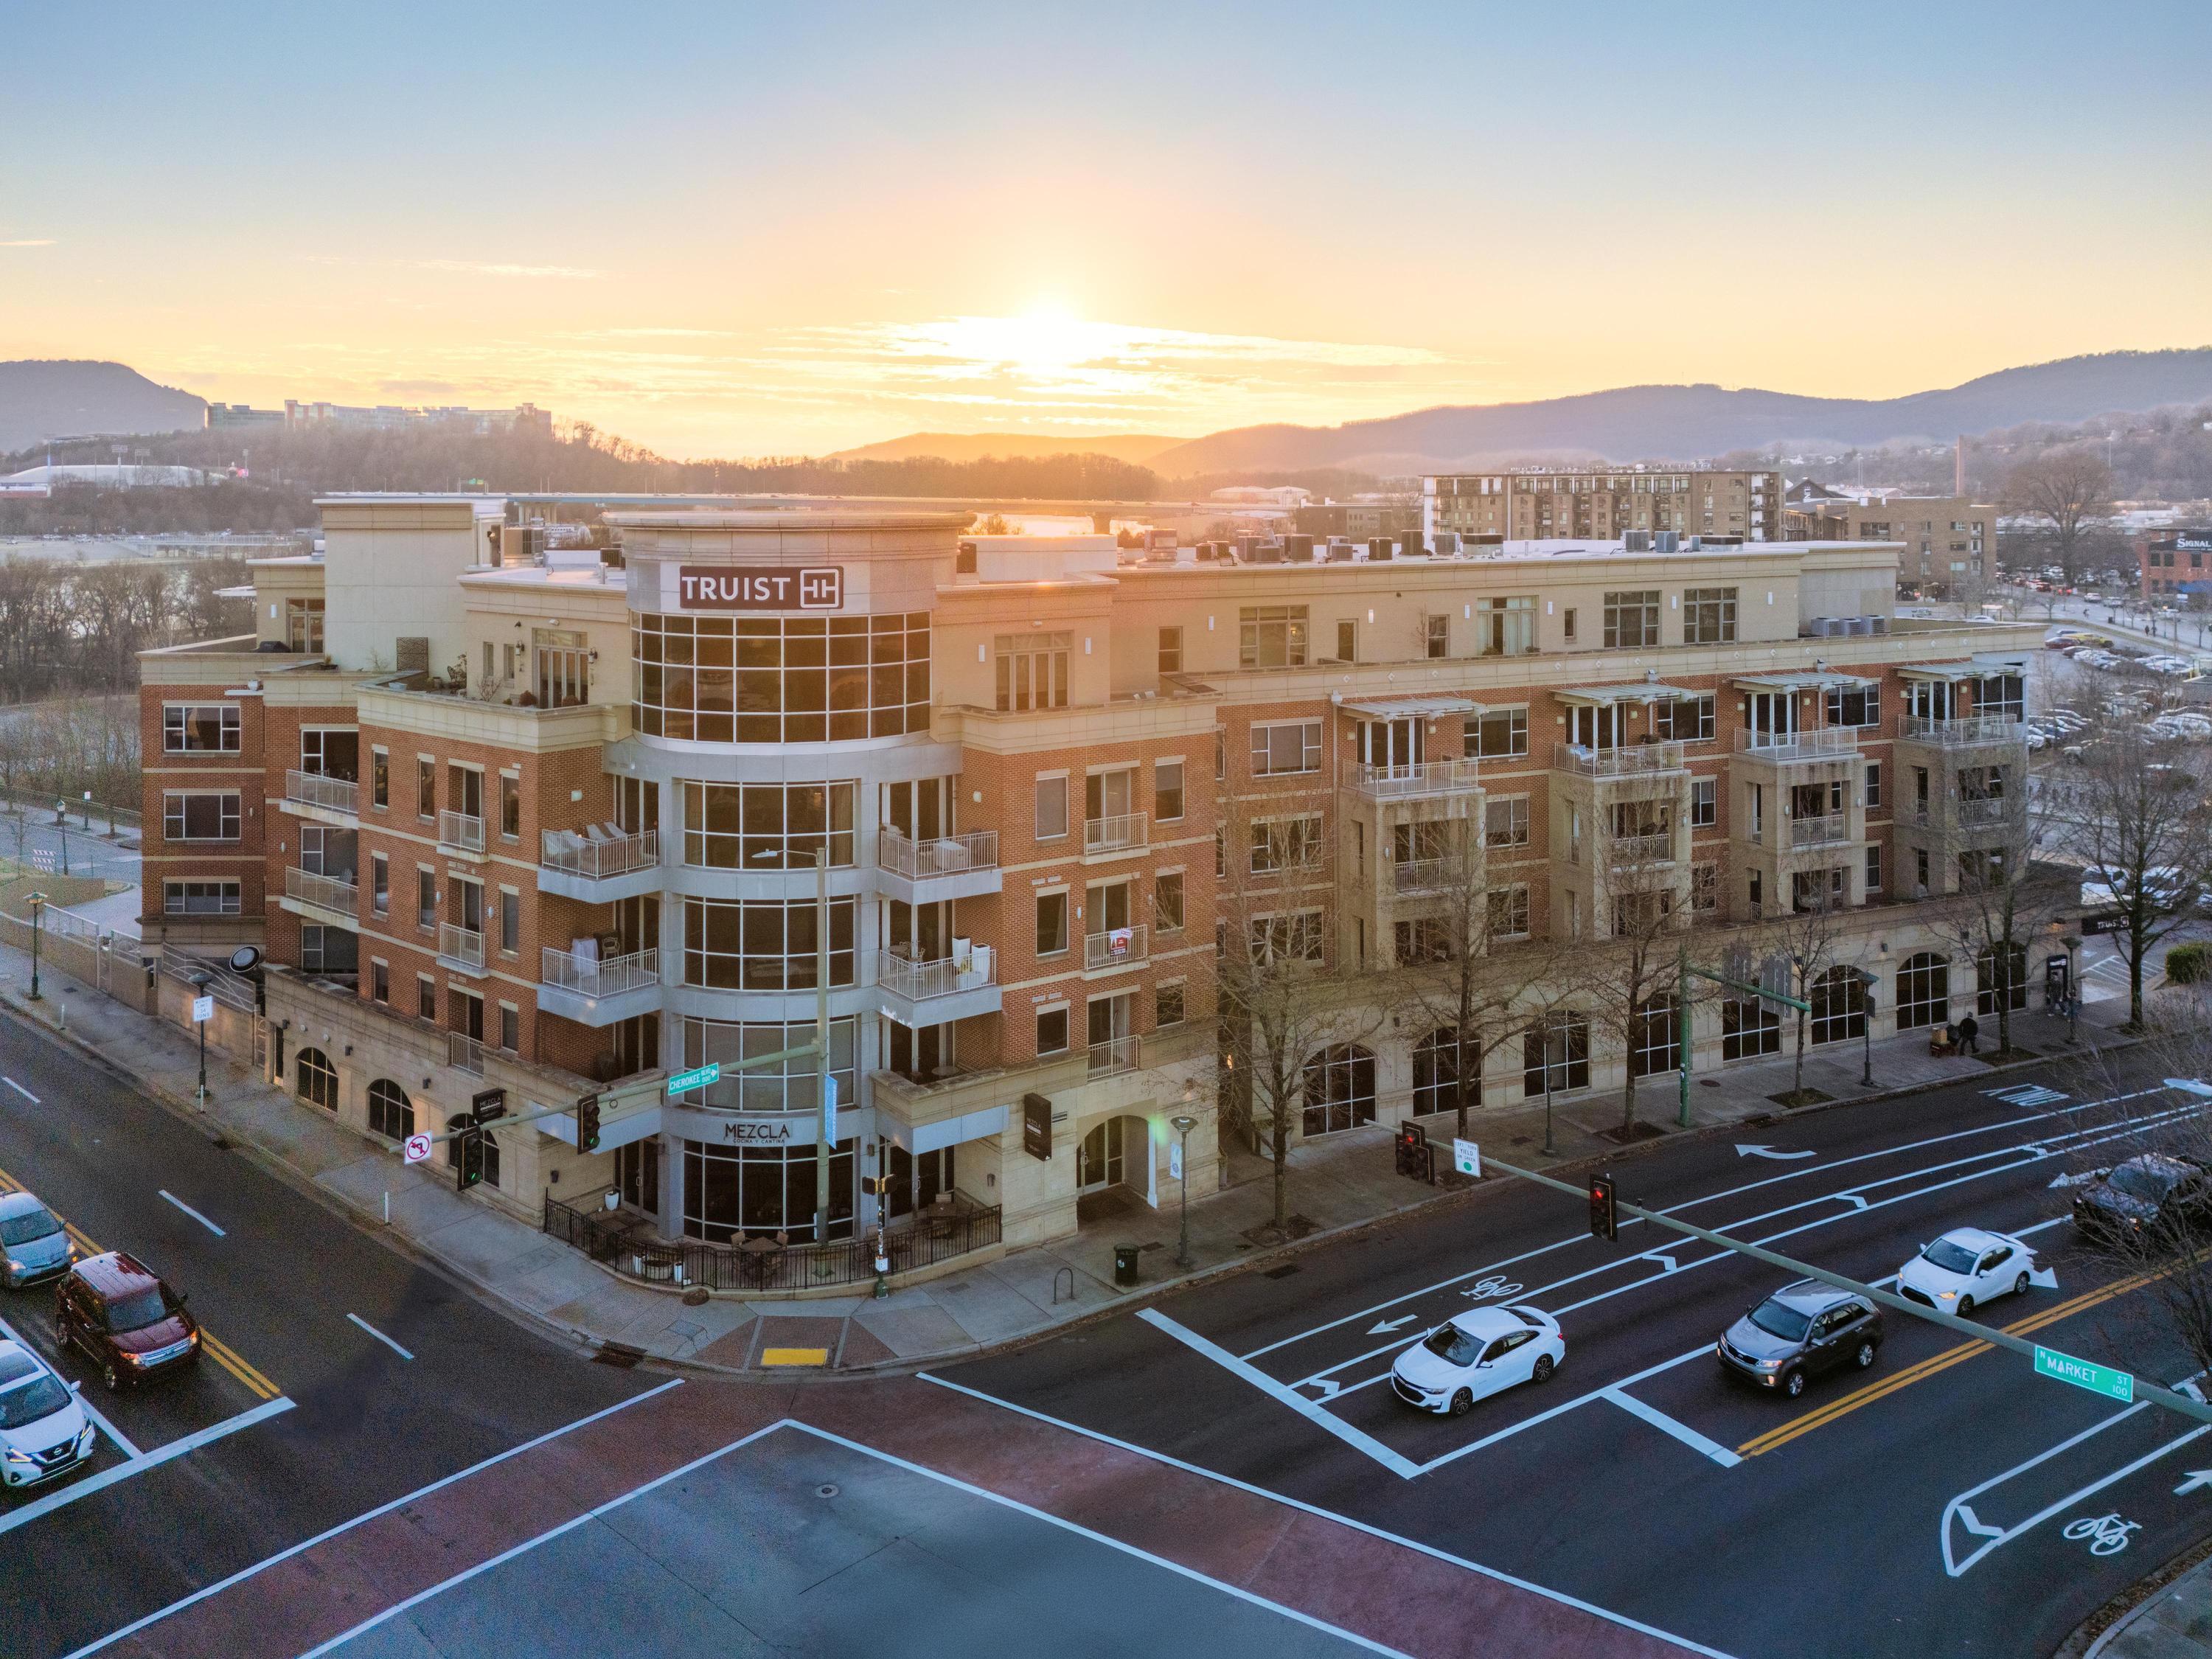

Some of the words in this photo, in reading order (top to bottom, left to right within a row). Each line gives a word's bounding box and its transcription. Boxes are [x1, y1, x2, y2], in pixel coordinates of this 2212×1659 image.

[2177, 538, 2212, 548] SIGNAL
[682, 577, 790, 600] TRUIST
[670, 1073, 700, 1089] CHEROKEE
[479, 1096, 501, 1107] MEZCLA
[725, 1122, 790, 1139] MEZCLA
[1460, 1148, 1473, 1157] YIELD
[2039, 1350, 2046, 1359] N
[2047, 1356, 2097, 1382] MARKET
[2117, 1375, 2129, 1385] ST
[2112, 1384, 2128, 1397] 100
